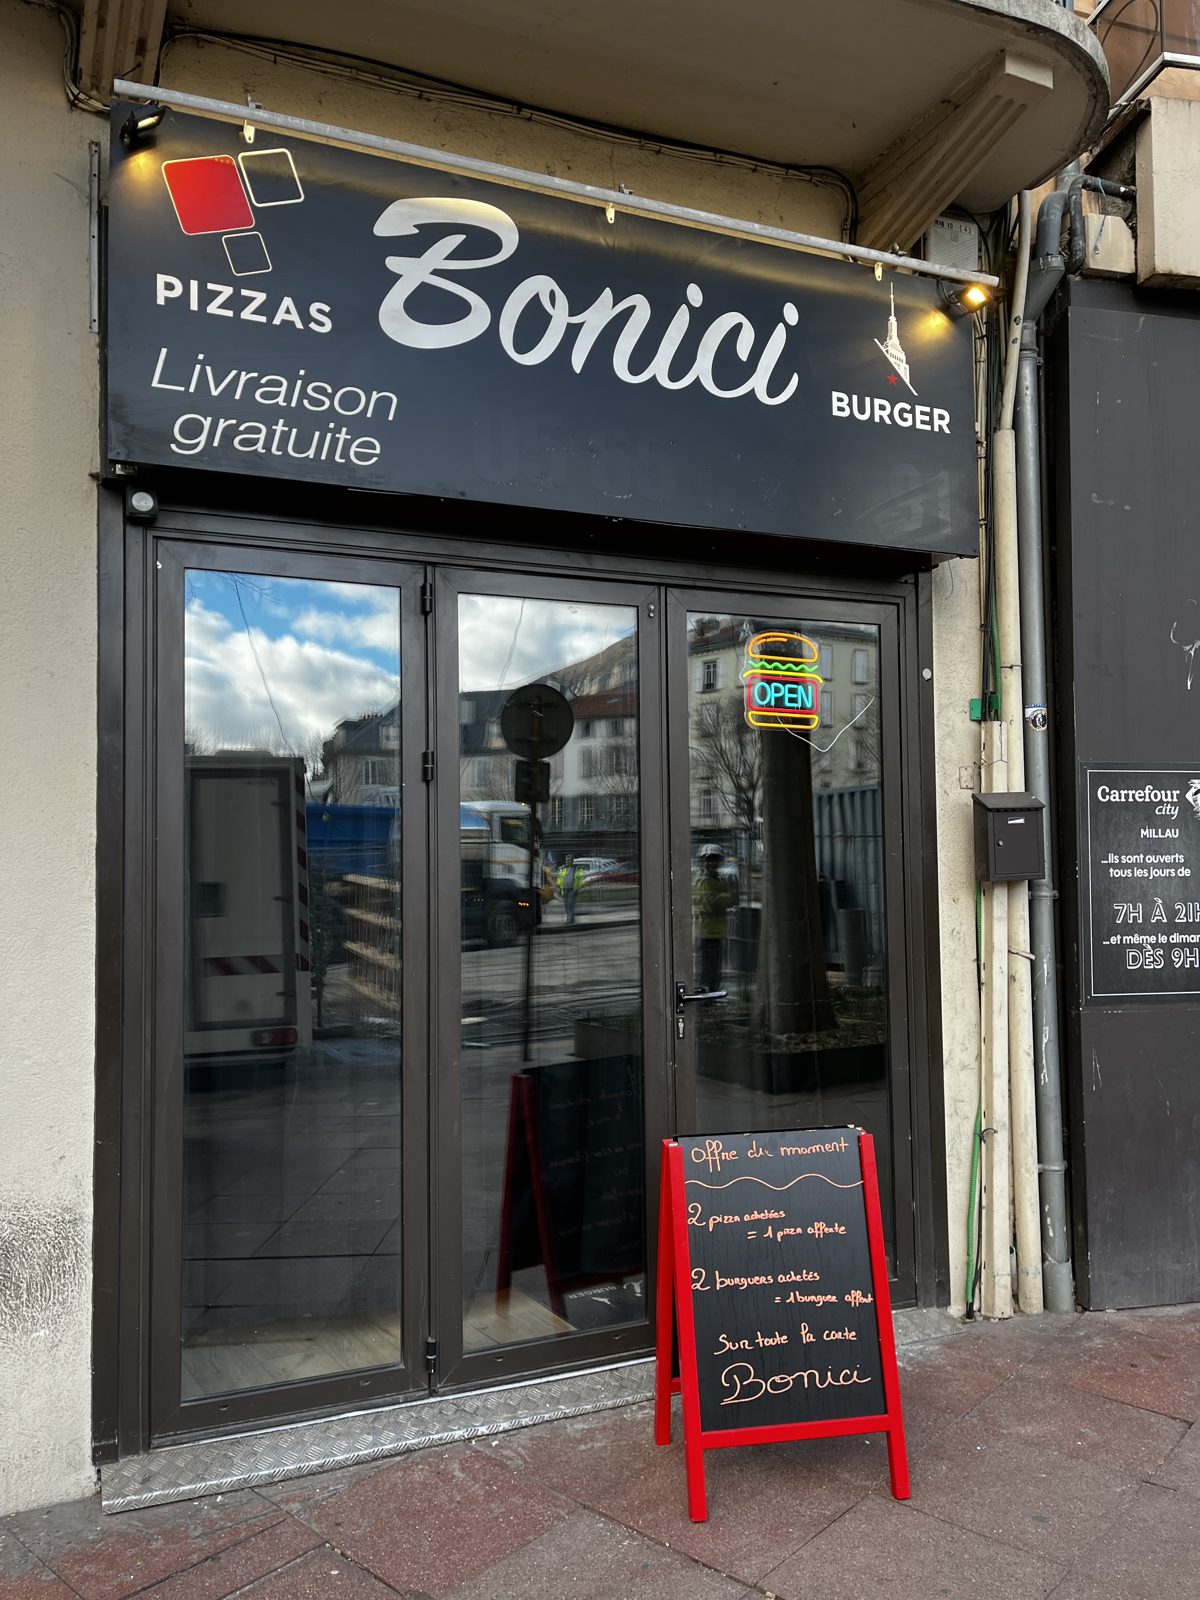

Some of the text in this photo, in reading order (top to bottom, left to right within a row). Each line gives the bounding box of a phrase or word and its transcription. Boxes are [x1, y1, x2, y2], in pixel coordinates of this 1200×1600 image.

[155, 273, 333, 334] PIZZAS
[372, 196, 800, 406] Bonici
[150, 347, 399, 421] Livraison
[831, 390, 951, 434] BURGER
[170, 412, 382, 466] gratuite
[753, 681, 813, 708] OPEN
[1097, 785, 1180, 802] Carrefour
[1155, 803, 1180, 820] city
[1140, 828, 1180, 838] MILLAU
[1120, 853, 1144, 864] sont
[1145, 853, 1185, 864] ouverts
[1109, 866, 1191, 880] tous les jours de
[1113, 903, 1143, 923] 7H
[1150, 897, 1168, 923] À
[1122, 933, 1157, 944] même
[1158, 932, 1168, 944] le
[1126, 943, 1200, 970] DÈS 9H
[691, 1136, 849, 1173] Offre du moment
[687, 1202, 706, 1226] 2
[708, 1214, 741, 1232] pizza
[763, 1225, 773, 1238] 1
[776, 1227, 803, 1242] pizza
[807, 1221, 847, 1239] offerte
[691, 1267, 711, 1291] 2
[713, 1322, 857, 1355] Sur toute la carte
[720, 1362, 872, 1405] Bonici
